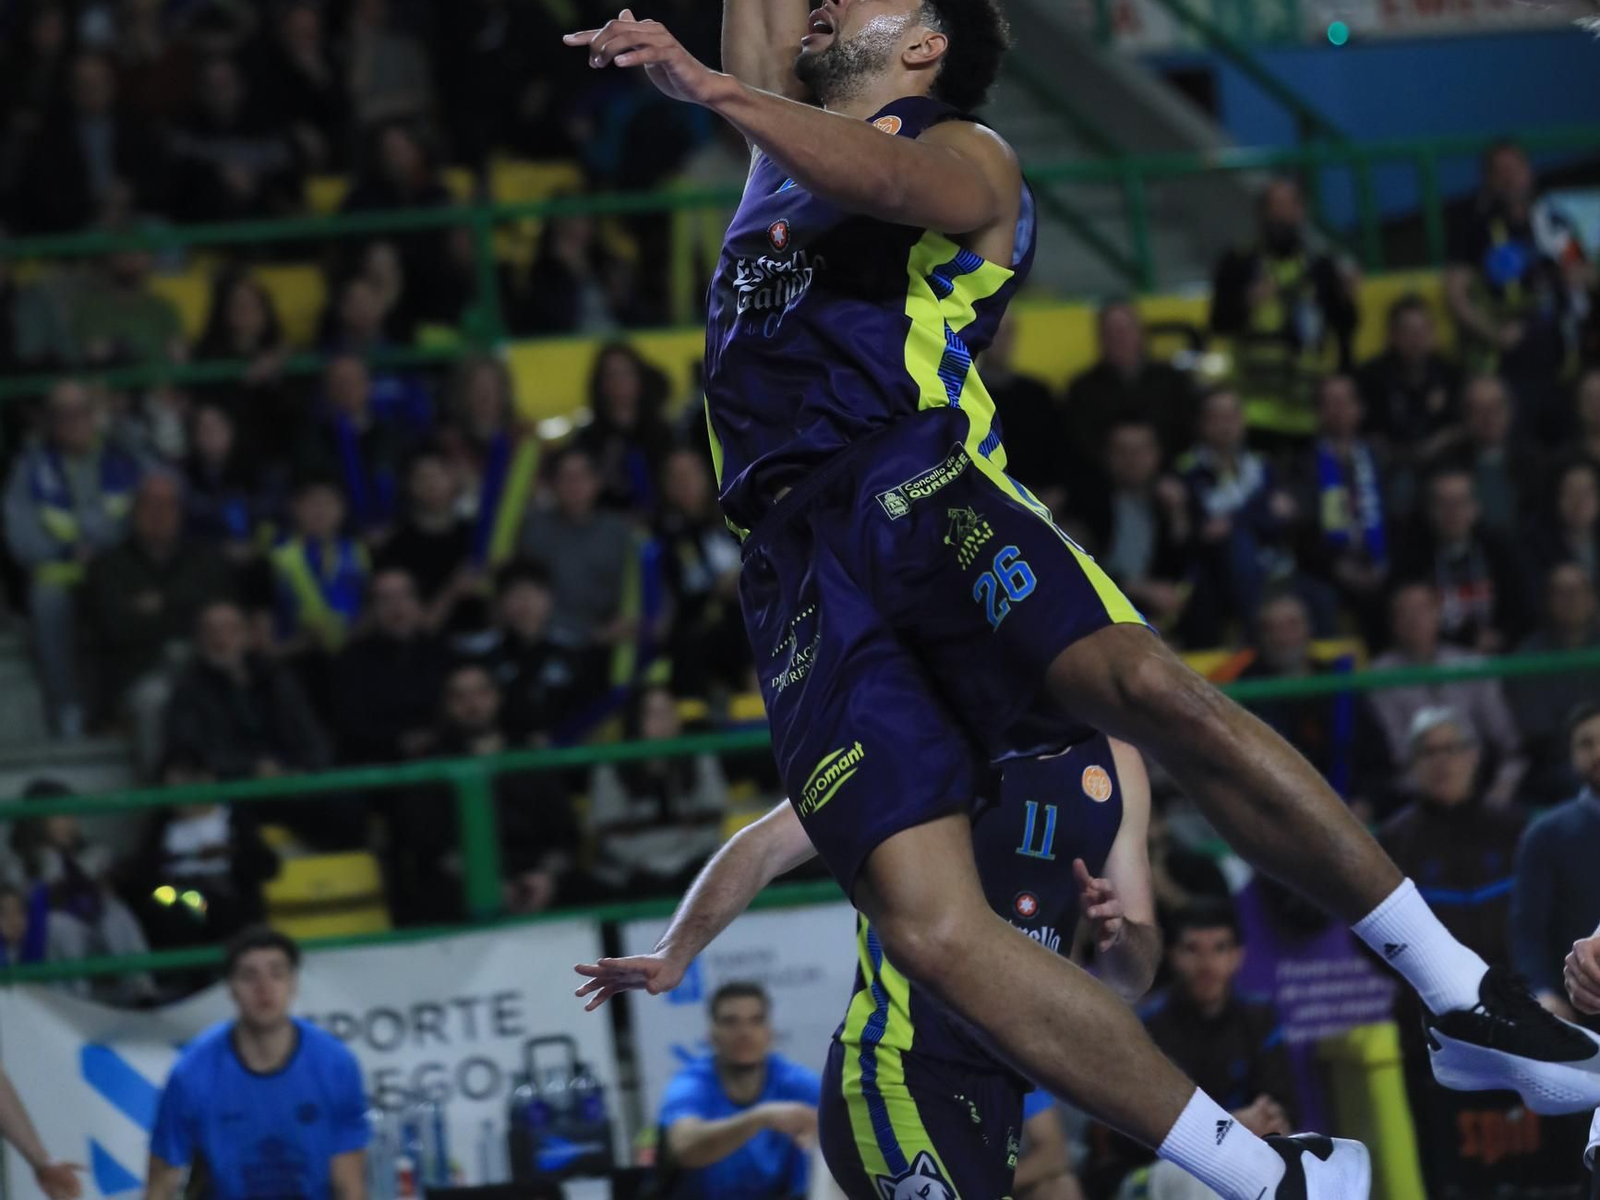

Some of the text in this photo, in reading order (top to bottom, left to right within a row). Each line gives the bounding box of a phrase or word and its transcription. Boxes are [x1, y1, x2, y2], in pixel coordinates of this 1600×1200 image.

[904, 455, 956, 491] Concello de
[908, 452, 969, 499] OURENSE
[973, 545, 1038, 633] 26
[1015, 799, 1058, 861] 11
[312, 988, 526, 1051] PORTE
[368, 1054, 502, 1114] EGO
